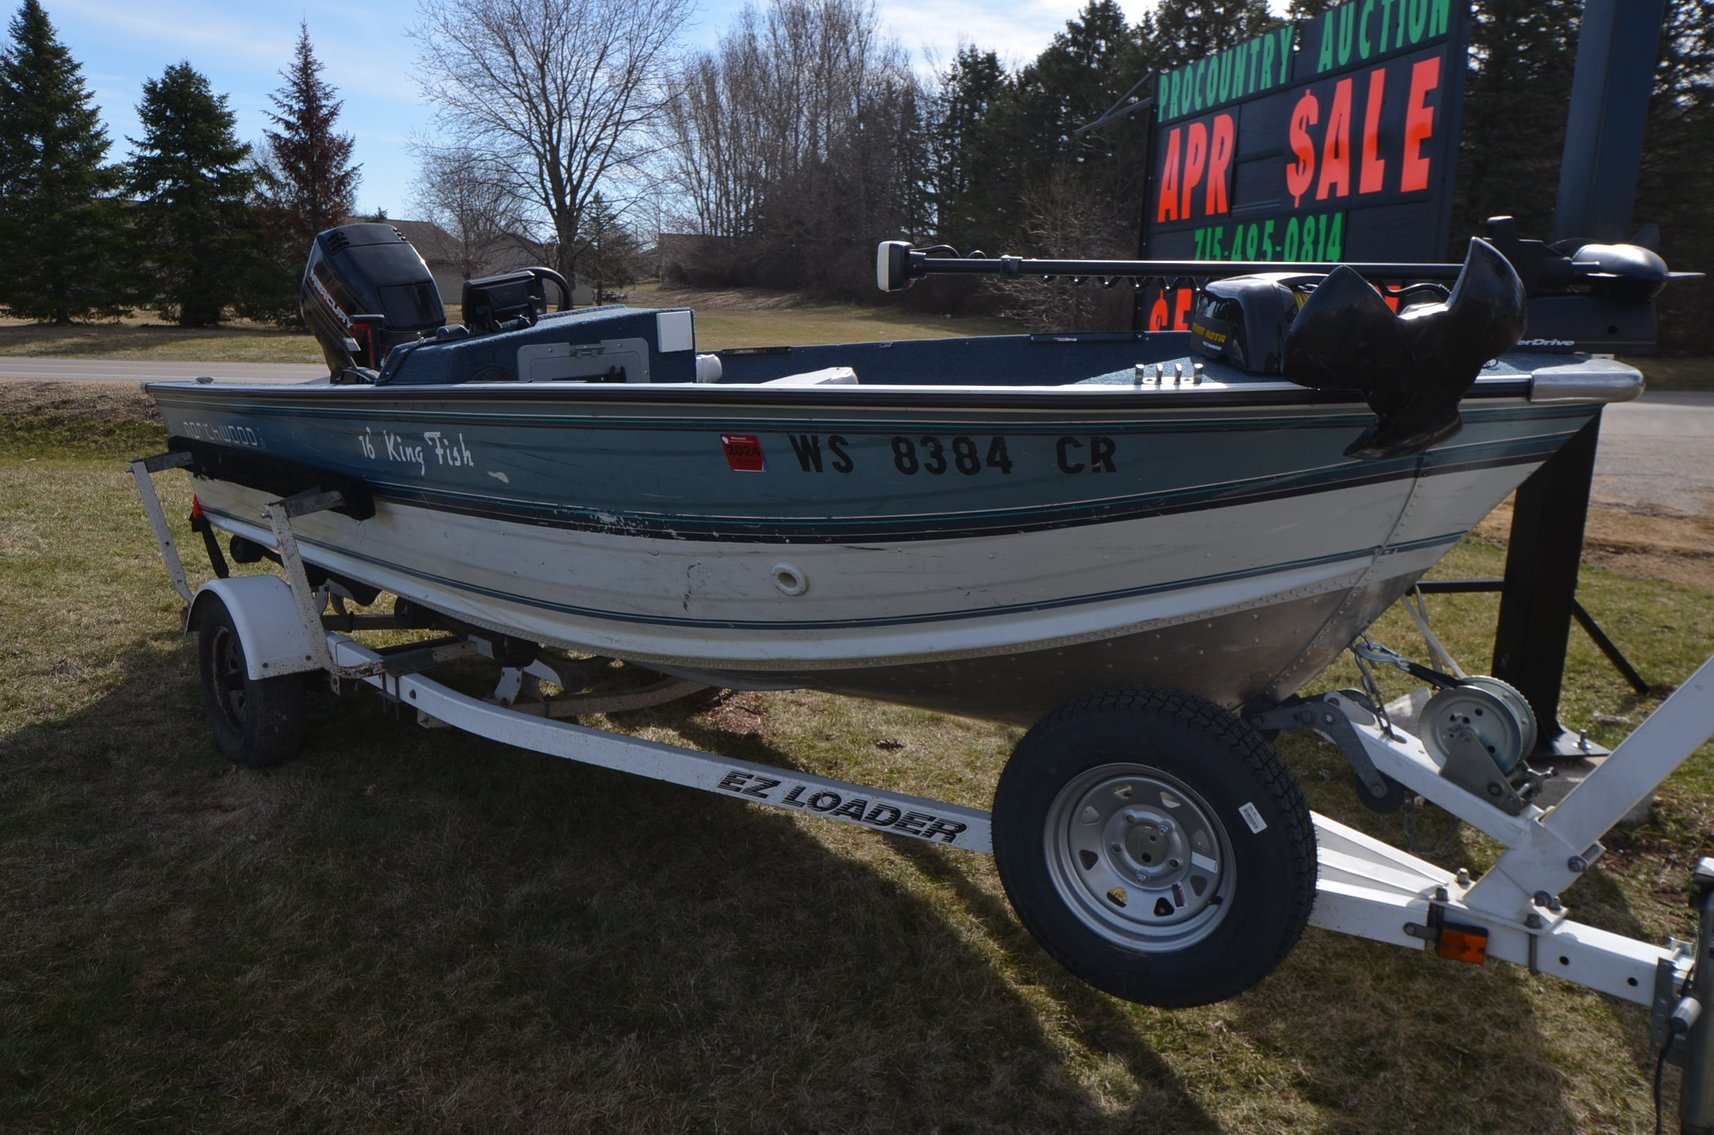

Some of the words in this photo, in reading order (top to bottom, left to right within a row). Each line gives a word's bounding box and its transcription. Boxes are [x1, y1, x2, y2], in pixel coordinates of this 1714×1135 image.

[1158, 25, 1294, 123] PROCOUNTRY
[1317, 0, 1450, 73] AUCTION
[1157, 113, 1235, 223] APR
[1194, 212, 1343, 262] 715-495-0814
[1516, 338, 1575, 347] erDrive
[383, 430, 425, 476] King
[424, 431, 474, 467] Fish
[789, 433, 855, 474] WS
[891, 435, 1013, 475] 8384
[1055, 436, 1118, 475] CR
[717, 770, 781, 799] EZ
[782, 786, 968, 844] LOADER
